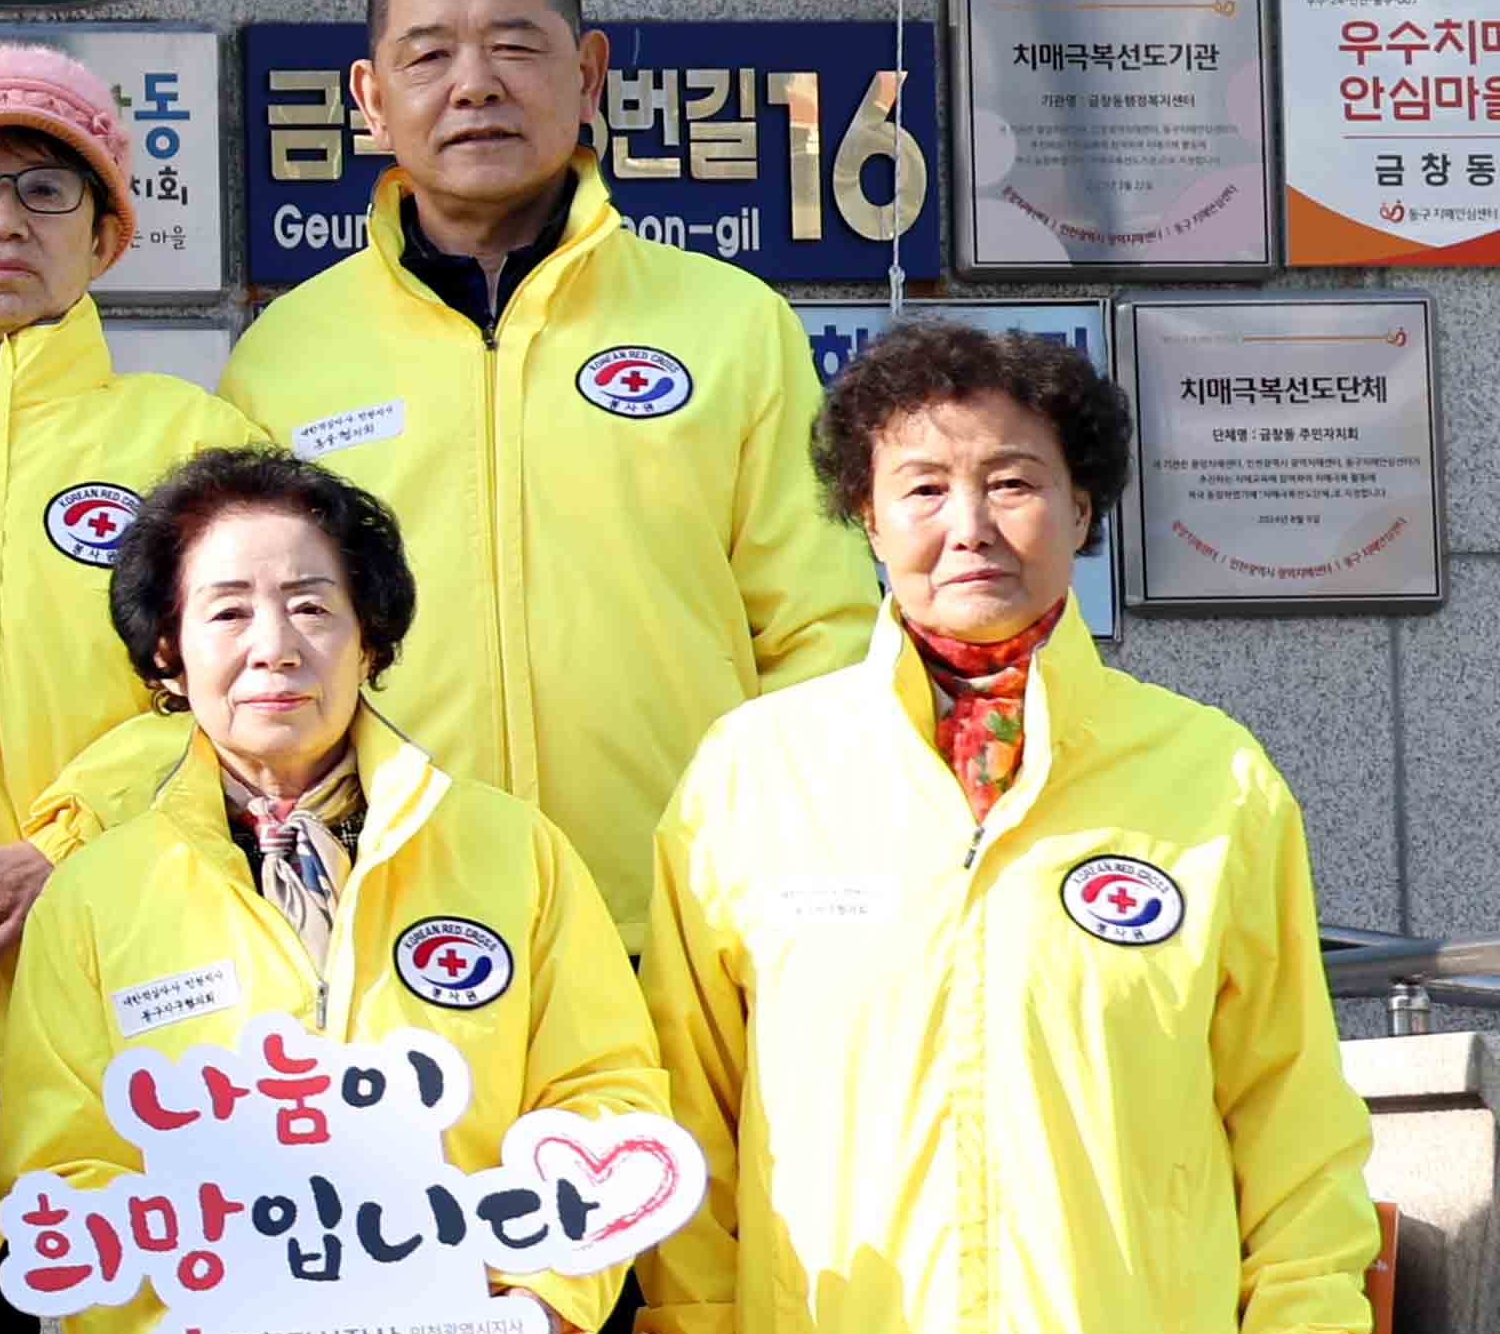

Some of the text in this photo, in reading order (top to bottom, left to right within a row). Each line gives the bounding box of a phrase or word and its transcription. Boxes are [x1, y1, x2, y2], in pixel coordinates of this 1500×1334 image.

[1012, 43, 1221, 73] 치매극복선도기관
[768, 70, 928, 242] 16
[150, 225, 188, 251] 마을
[1180, 375, 1388, 406] 치매극복선도단체
[441, 923, 463, 936] RED
[129, 1033, 445, 1145] 나눔이
[22, 1174, 601, 1293] 희망입니다
